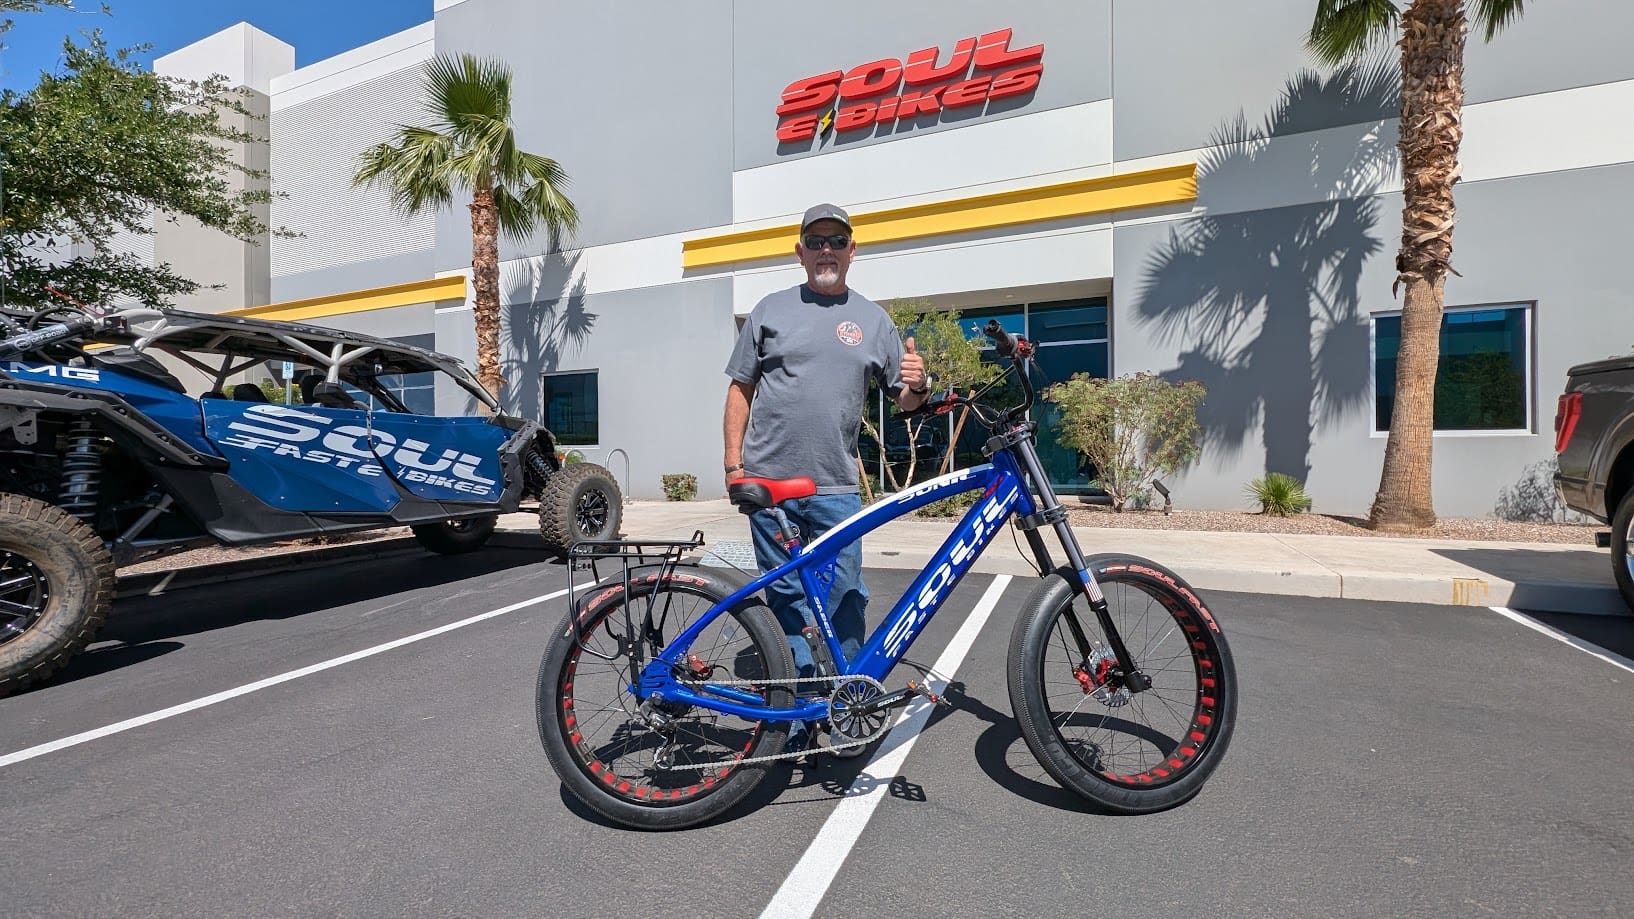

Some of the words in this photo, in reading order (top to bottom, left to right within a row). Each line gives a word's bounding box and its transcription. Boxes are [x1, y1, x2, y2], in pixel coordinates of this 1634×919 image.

[776, 27, 1045, 115] SOUL
[834, 63, 1044, 132] BIKES
[218, 433, 361, 468] FAST
[404, 470, 494, 496] BIKES
[228, 404, 496, 486] SOUL
[883, 485, 1018, 659] SOUL
